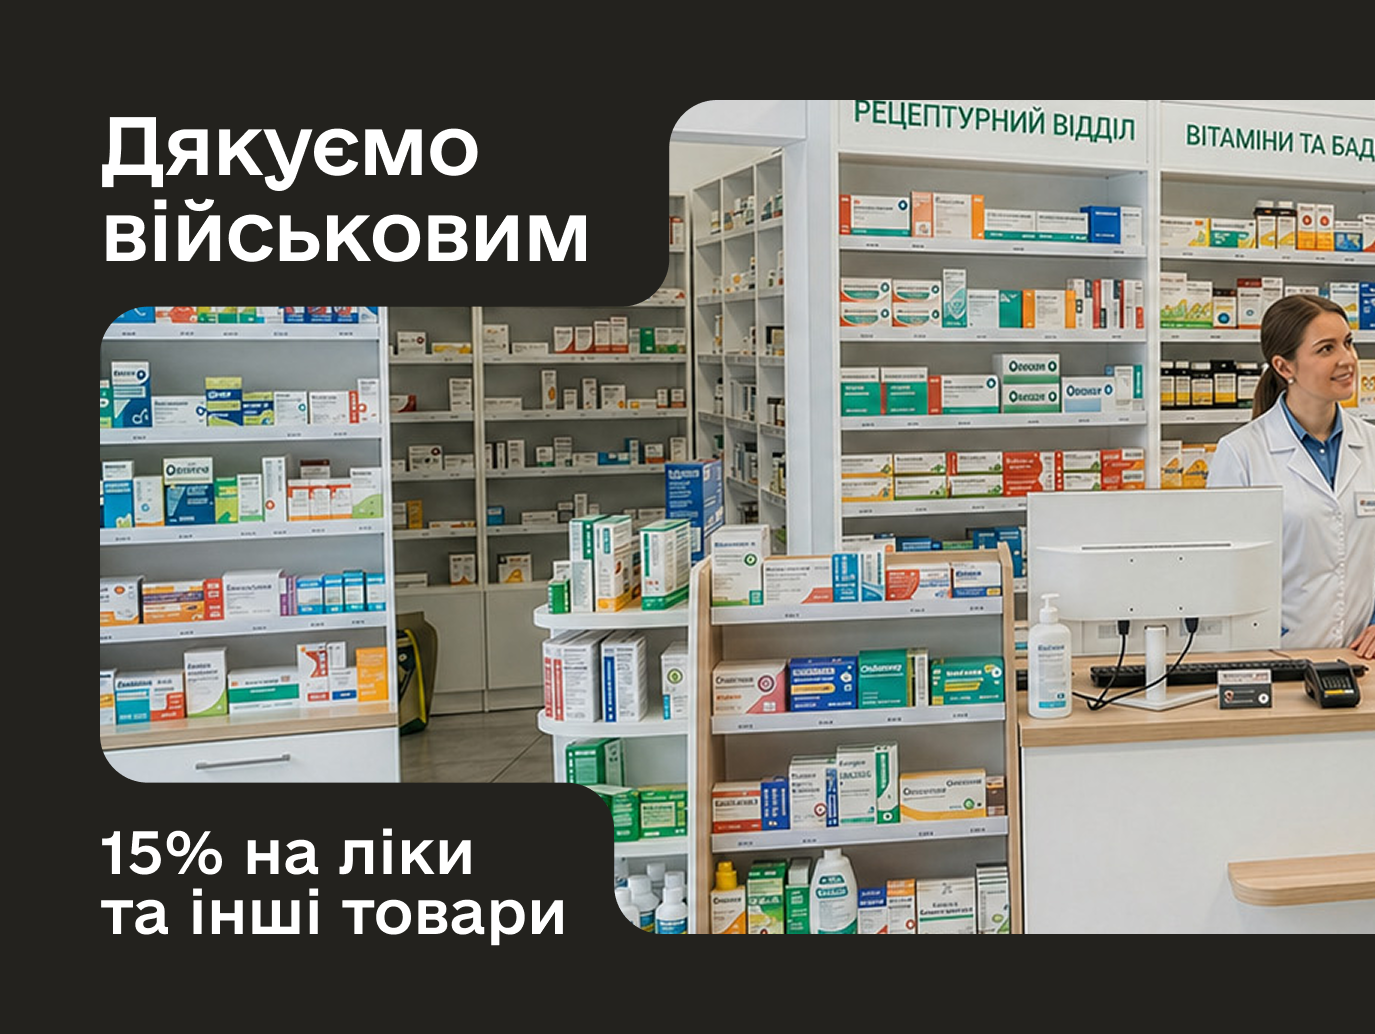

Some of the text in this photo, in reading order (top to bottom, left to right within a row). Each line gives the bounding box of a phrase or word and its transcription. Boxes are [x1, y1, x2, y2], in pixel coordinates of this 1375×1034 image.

[854, 100, 1135, 143] РЕЦЕПТУРНИЙ ВІДДІЛ
[1186, 124, 1293, 151] ВІТАМІНИ
[1300, 133, 1325, 154] ТА
